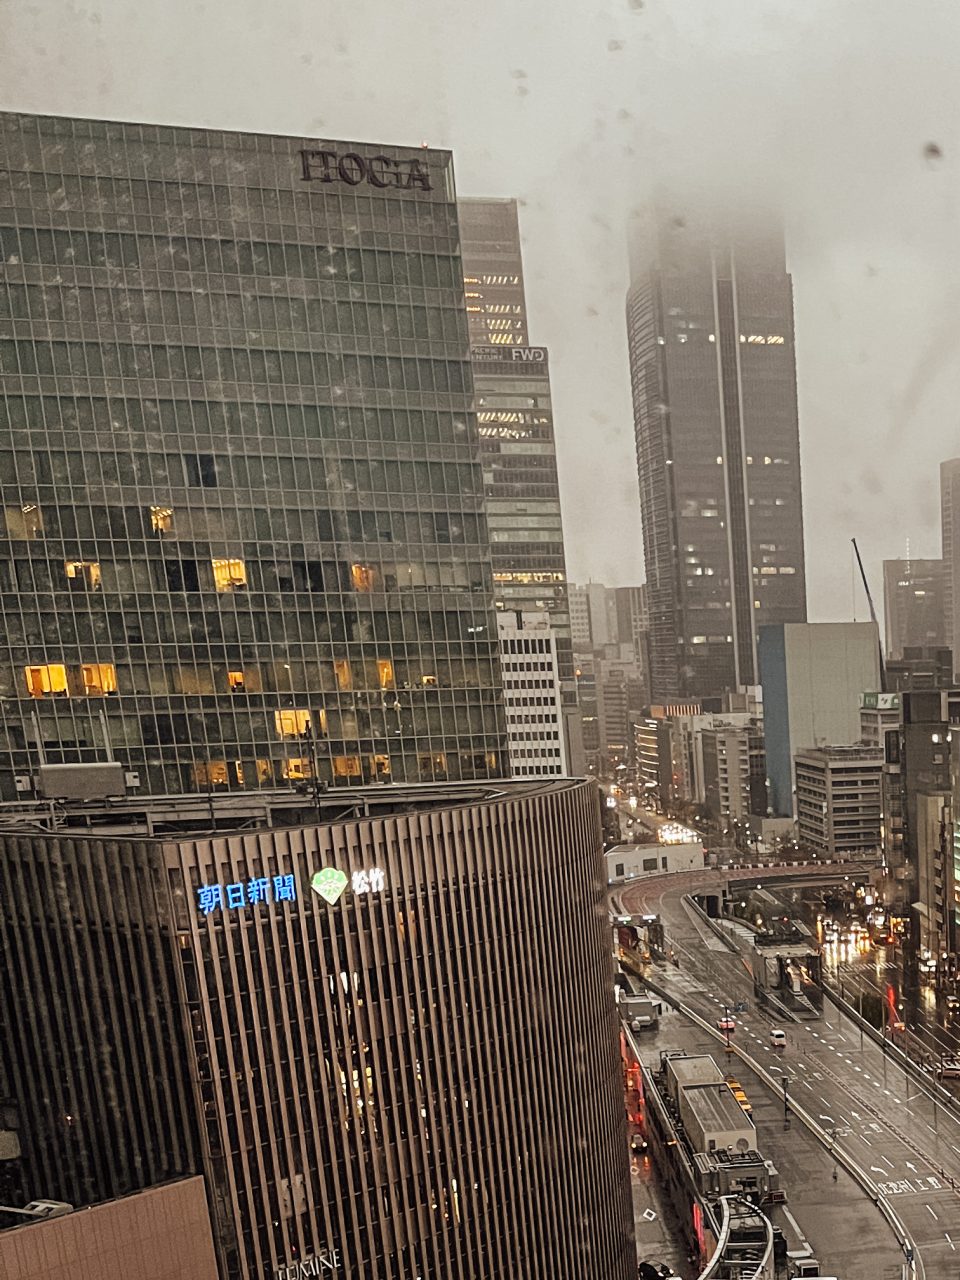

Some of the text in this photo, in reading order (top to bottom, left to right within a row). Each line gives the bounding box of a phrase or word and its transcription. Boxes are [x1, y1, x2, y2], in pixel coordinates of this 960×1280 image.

[511, 348, 544, 361] FWD
[197, 873, 297, 915] 朝日新聞
